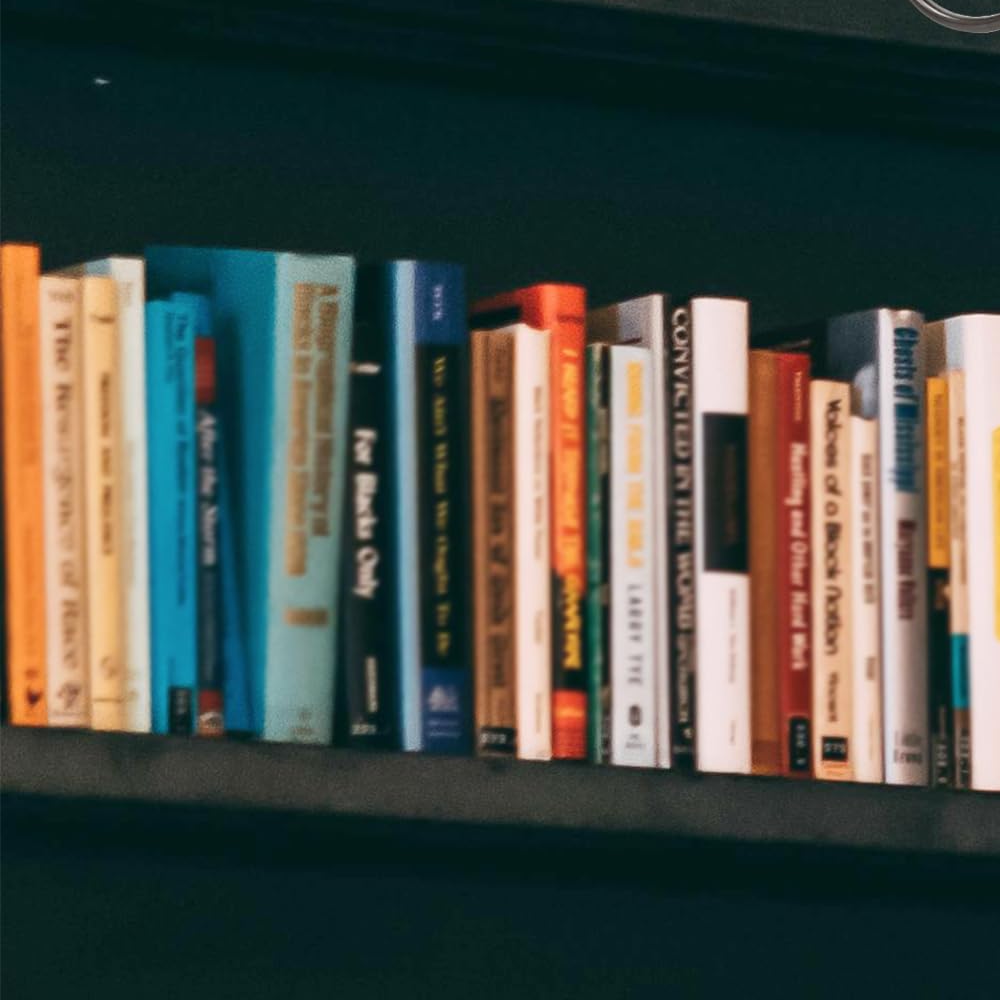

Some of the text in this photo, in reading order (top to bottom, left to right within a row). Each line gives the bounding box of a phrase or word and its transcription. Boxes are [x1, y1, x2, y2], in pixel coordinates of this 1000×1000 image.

[53, 318, 75, 374] The
[893, 326, 919, 381] Ghosts
[893, 384, 919, 399] of
[199, 410, 217, 461] After
[826, 399, 846, 468] Voices
[889, 402, 919, 494] Mississippi
[200, 467, 217, 495] the
[669, 308, 694, 630] CONVICTED IN THE WOMB
[826, 474, 846, 496] of
[202, 502, 219, 567] Storm
[352, 429, 379, 599] For Blacks Only
[431, 357, 449, 657] We Ain't What We Ought To Be
[826, 500, 846, 516] a
[61, 560, 84, 589] of
[784, 442, 807, 670] Hustling and Other Hard Work
[826, 521, 846, 580] Black
[61, 600, 83, 670] Race
[626, 585, 645, 643] LARRY
[826, 584, 846, 656] Nation
[626, 652, 645, 686] TYE
